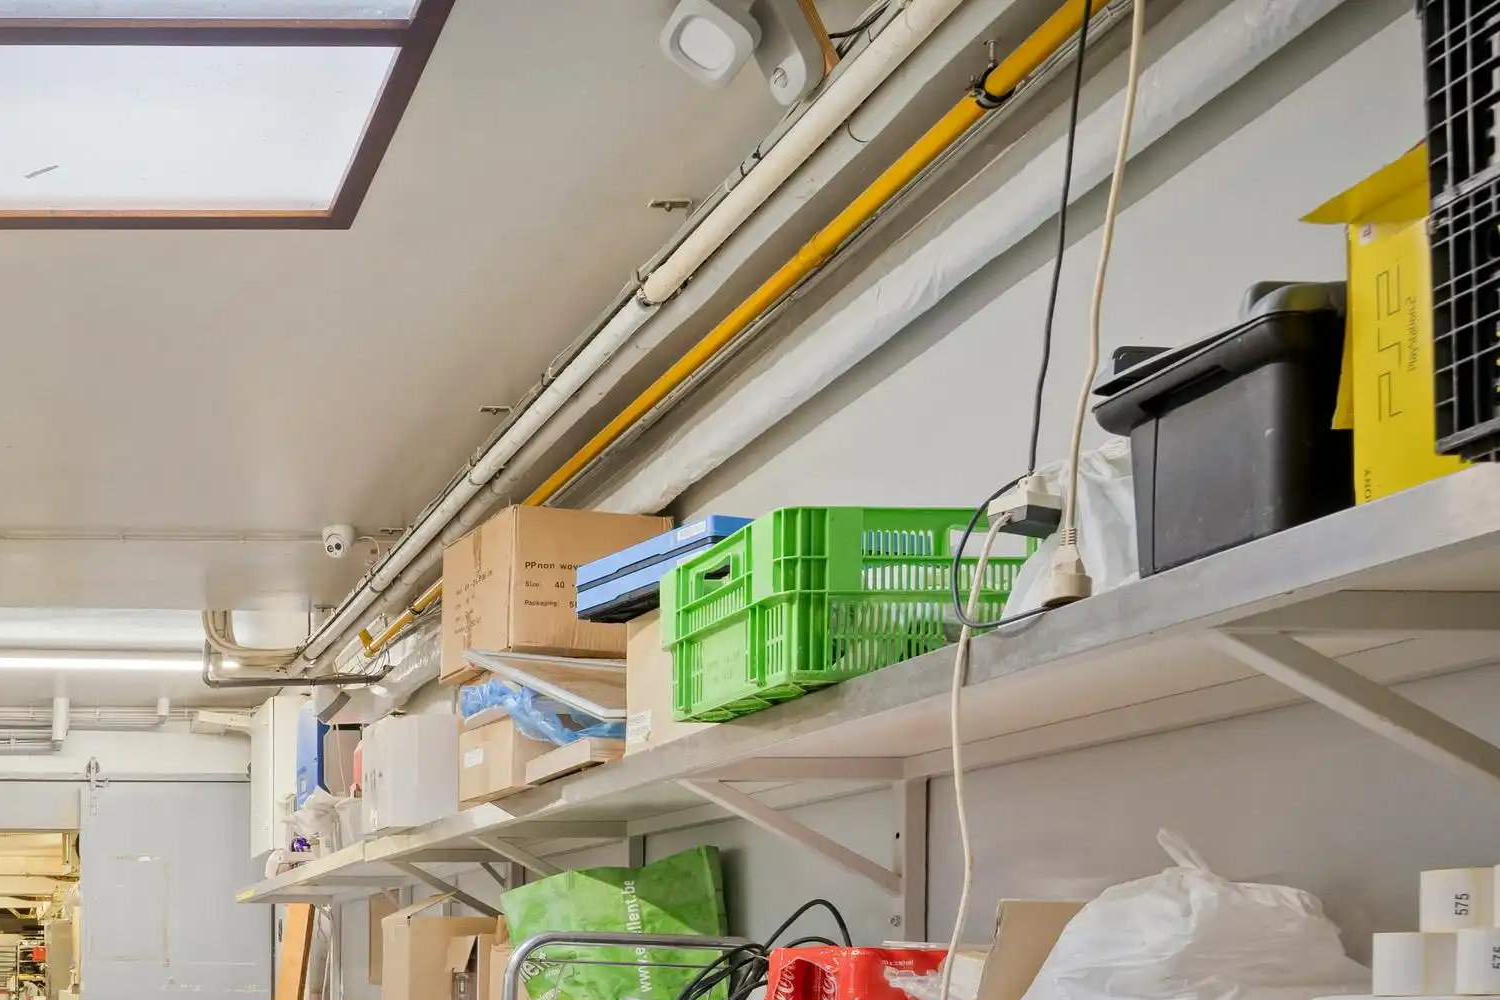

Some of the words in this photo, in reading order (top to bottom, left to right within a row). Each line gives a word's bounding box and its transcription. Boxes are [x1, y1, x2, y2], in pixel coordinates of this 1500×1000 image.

[1362, 468, 1372, 503] ONY
[525, 561, 555, 569] PPnon
[554, 581, 565, 589] 40
[1454, 893, 1470, 916] 575
[621, 880, 652, 993] www.ellent.be
